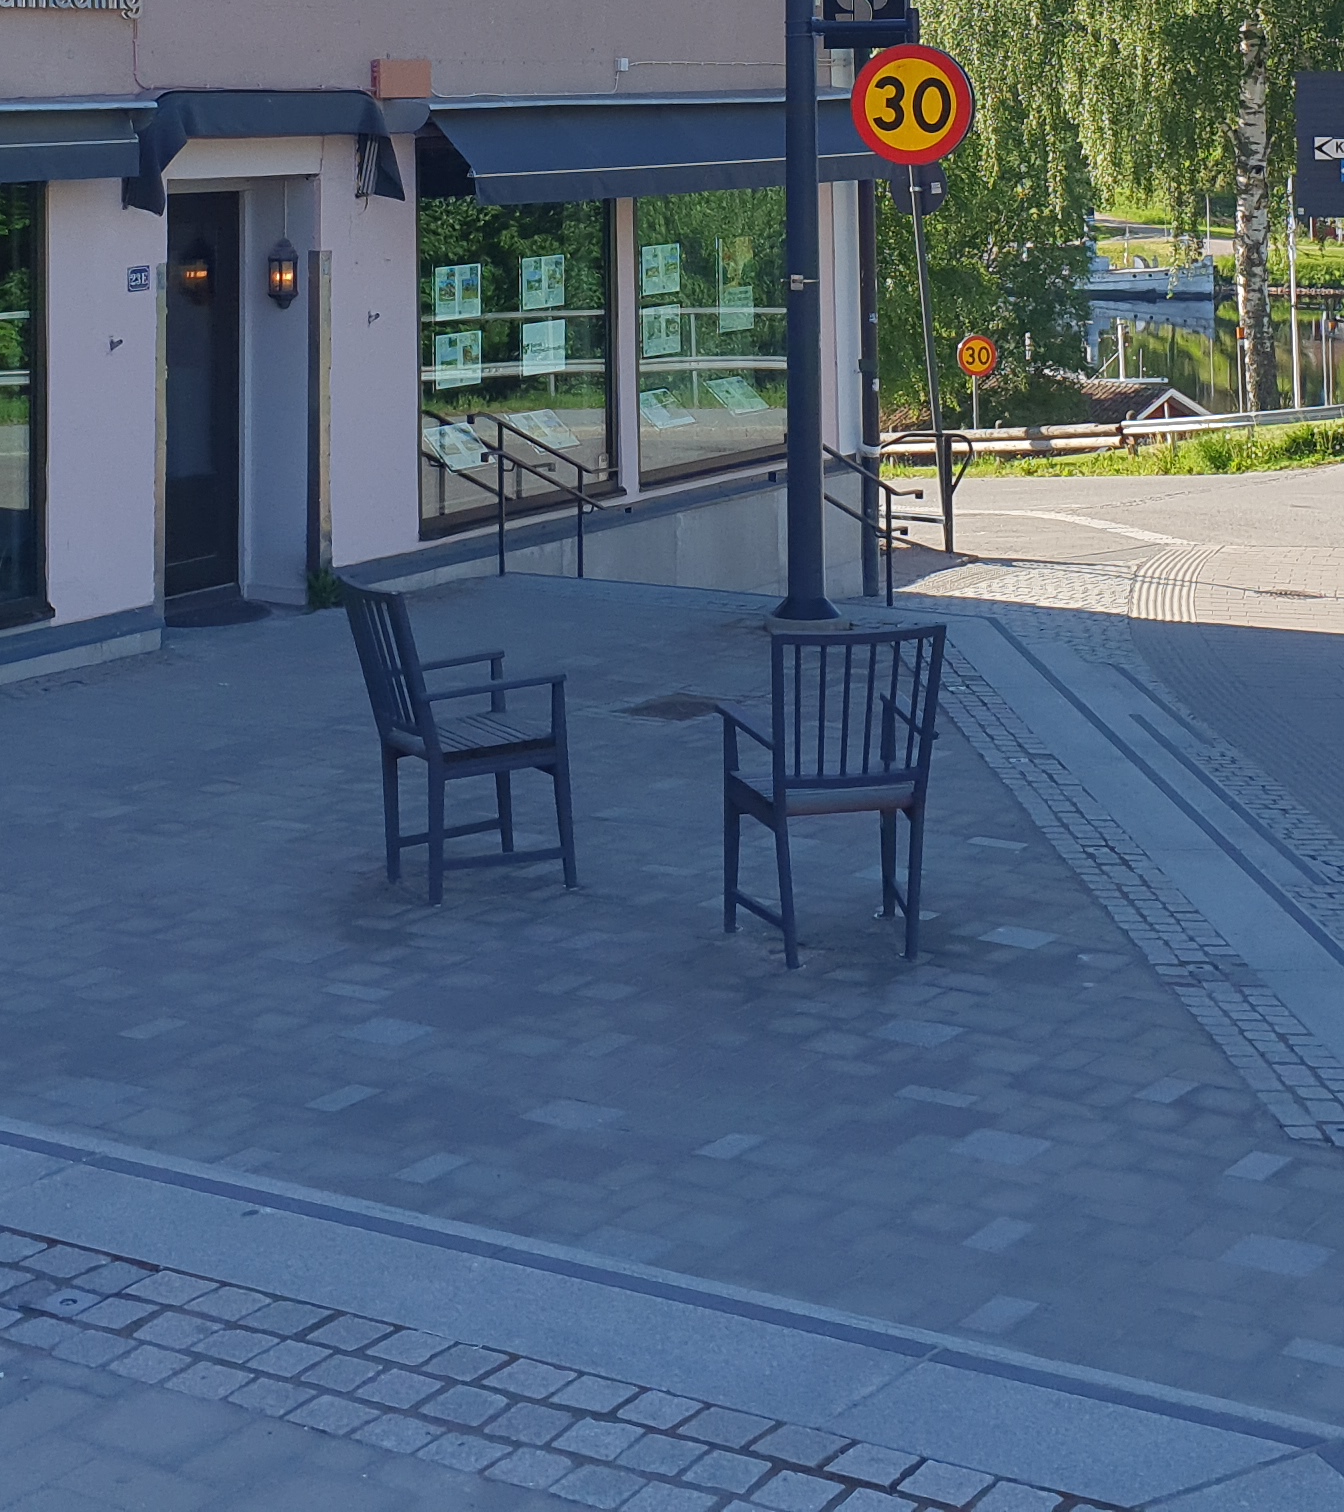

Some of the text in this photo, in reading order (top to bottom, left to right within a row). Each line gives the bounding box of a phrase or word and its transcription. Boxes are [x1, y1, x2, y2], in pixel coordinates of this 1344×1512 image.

[873, 75, 952, 134] 30
[129, 272, 148, 285] 23E
[965, 345, 991, 365] 30
